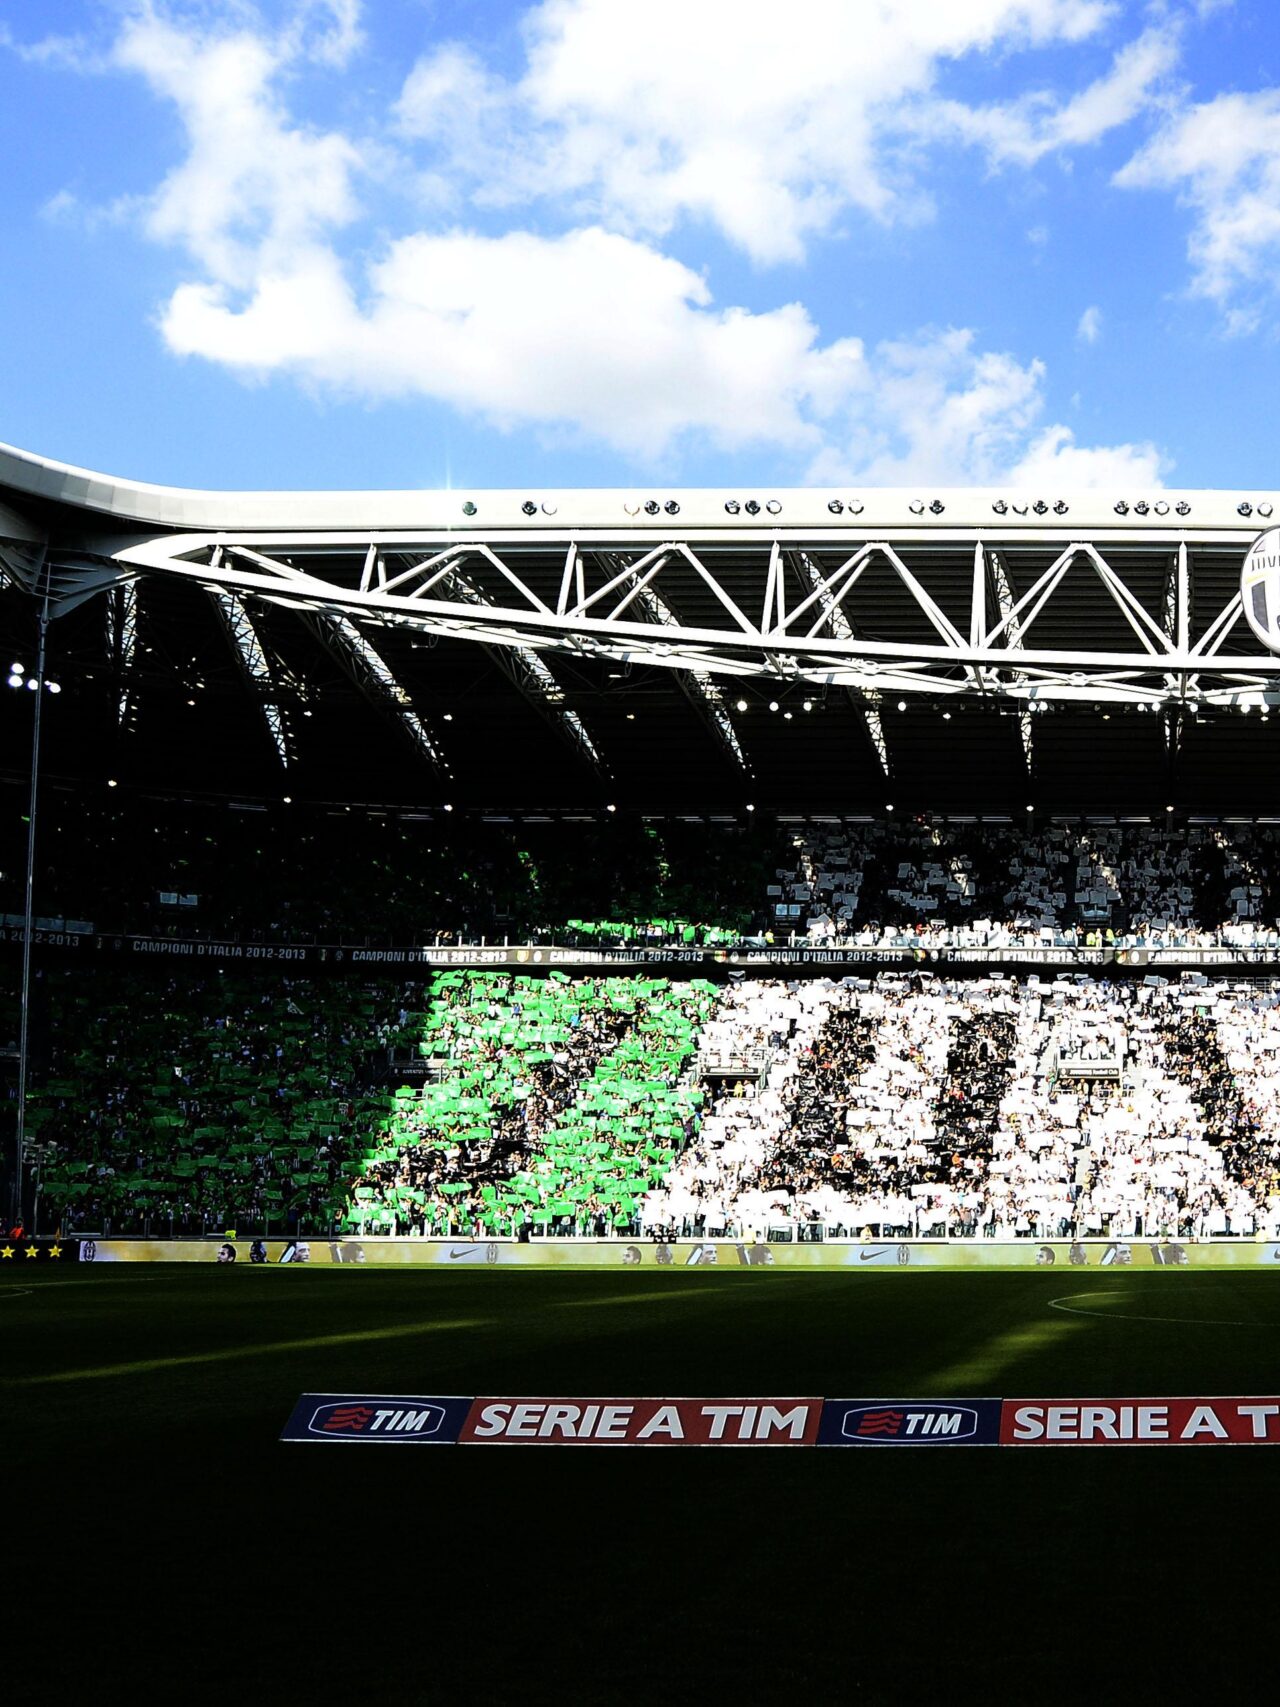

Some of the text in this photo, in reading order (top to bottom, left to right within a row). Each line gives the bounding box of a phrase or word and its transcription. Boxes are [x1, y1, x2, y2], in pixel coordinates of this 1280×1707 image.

[132, 940, 306, 960] CAMPIONI D'ITALIA 2012-2013
[352, 950, 507, 963] CAMPIONI D'ITALIA 2012-2013
[549, 951, 704, 963] CAMPIONI D'ITALIA 2012-2013
[747, 951, 903, 963] CAMPIONI D'ITALIA 2012-2013
[947, 951, 1000, 962] CAMPIONI
[1003, 951, 1044, 963] D'ITALIA
[1147, 951, 1201, 963] CAMPIONI
[369, 1410, 431, 1431] TIM
[473, 1404, 809, 1440] SERIE A TIM
[905, 1413, 963, 1434] TIM
[1013, 1406, 1169, 1440] SERIE
[1179, 1405, 1229, 1439] A
